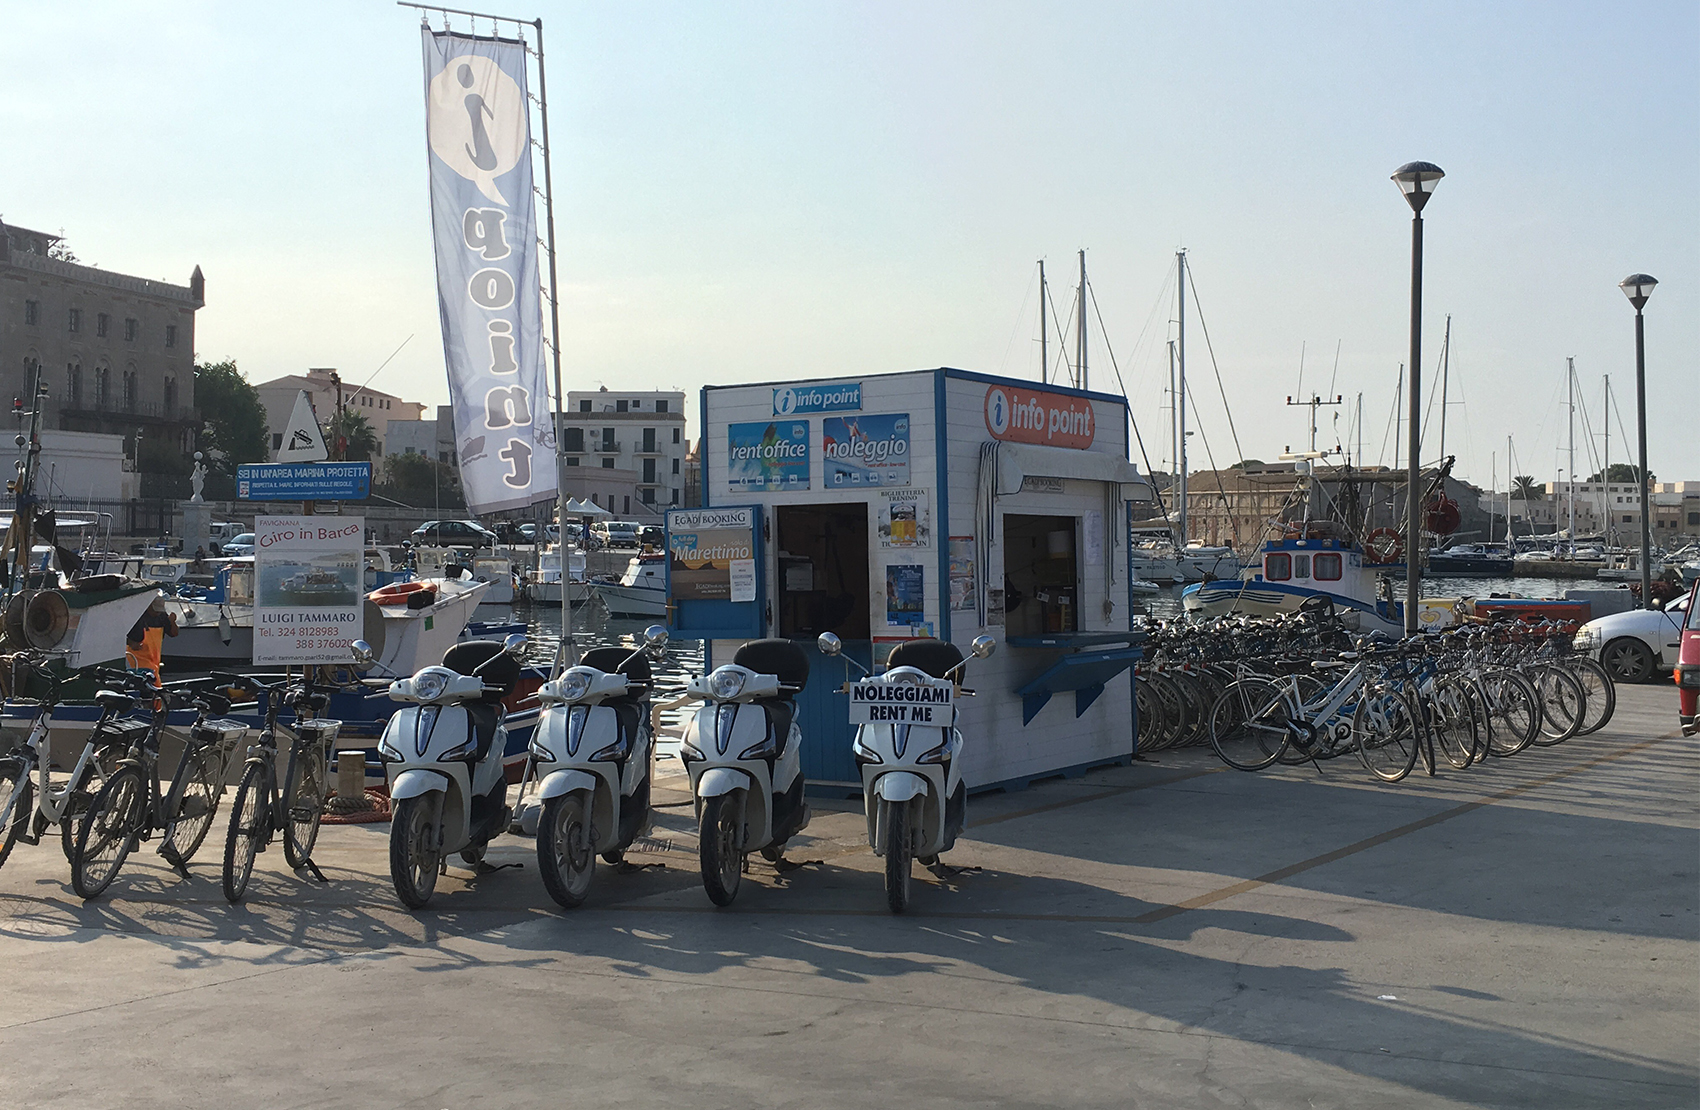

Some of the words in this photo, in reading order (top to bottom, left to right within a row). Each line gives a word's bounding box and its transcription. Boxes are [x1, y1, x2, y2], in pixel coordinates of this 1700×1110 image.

[797, 388, 822, 406] info
[822, 387, 860, 408] point
[1011, 394, 1045, 431] info
[1047, 404, 1091, 440] point
[895, 422, 907, 431] info
[731, 443, 763, 460] rent
[763, 439, 807, 459] office
[826, 433, 908, 462] noleggio
[238, 469, 250, 479] SEI
[251, 469, 259, 478] IN
[260, 468, 293, 478] UN'AREA
[294, 468, 325, 478] MARINA
[327, 467, 369, 477] PROTETTA
[880, 489, 925, 497] BIGLIETTERIA
[675, 515, 701, 525] EGADI
[702, 512, 746, 523] BOOKING
[260, 530, 295, 547] Giro
[300, 527, 313, 539] in
[317, 524, 360, 540] Barca
[674, 544, 749, 561] Marettimo
[262, 613, 294, 623] LUIGI
[298, 612, 356, 622] TAMMARO
[258, 627, 274, 637] Tel.
[278, 627, 296, 636] 324
[298, 627, 339, 637] 8128983
[296, 640, 314, 649] 388
[853, 685, 950, 703] NOLEGGIAMI
[869, 705, 908, 721] RENT
[911, 706, 933, 722] ME
